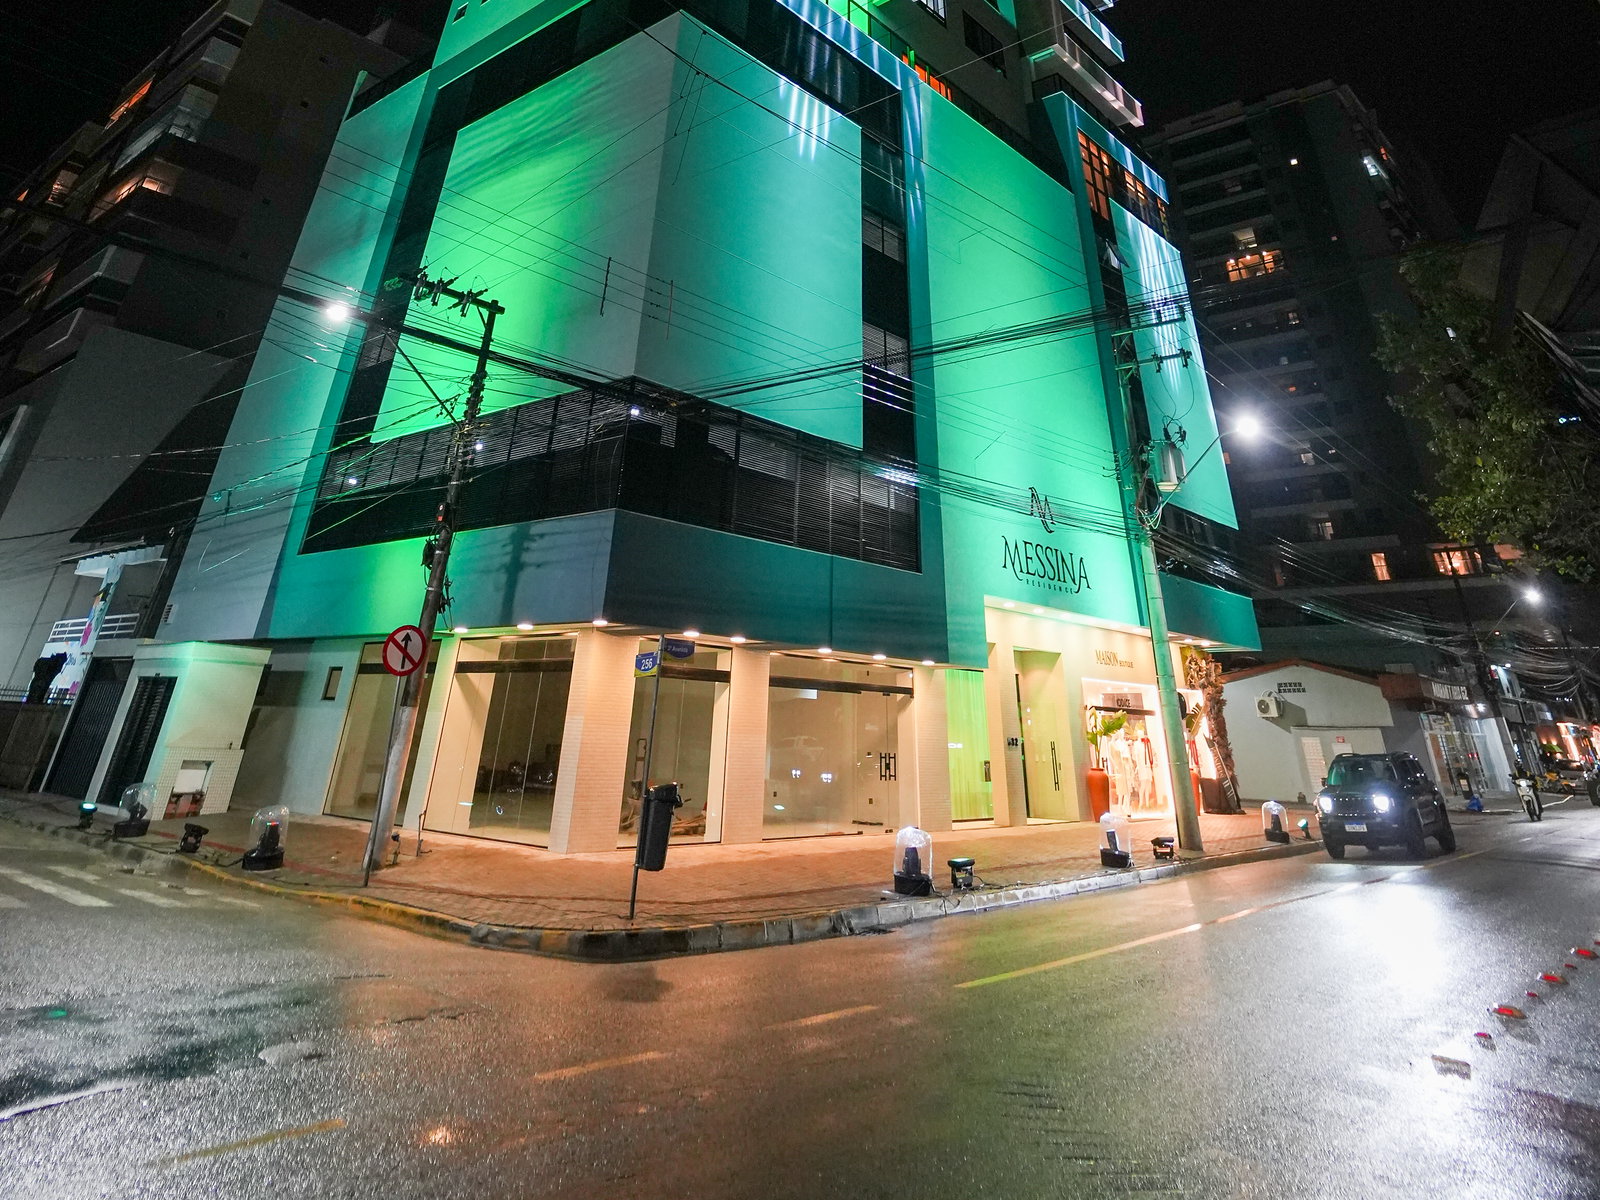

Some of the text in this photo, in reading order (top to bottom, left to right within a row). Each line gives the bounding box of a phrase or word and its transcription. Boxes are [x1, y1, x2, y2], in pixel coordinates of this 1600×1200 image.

[1001, 535, 1092, 594] MESSINA
[1026, 578, 1074, 595] RESIDENCE
[641, 658, 653, 670] 256
